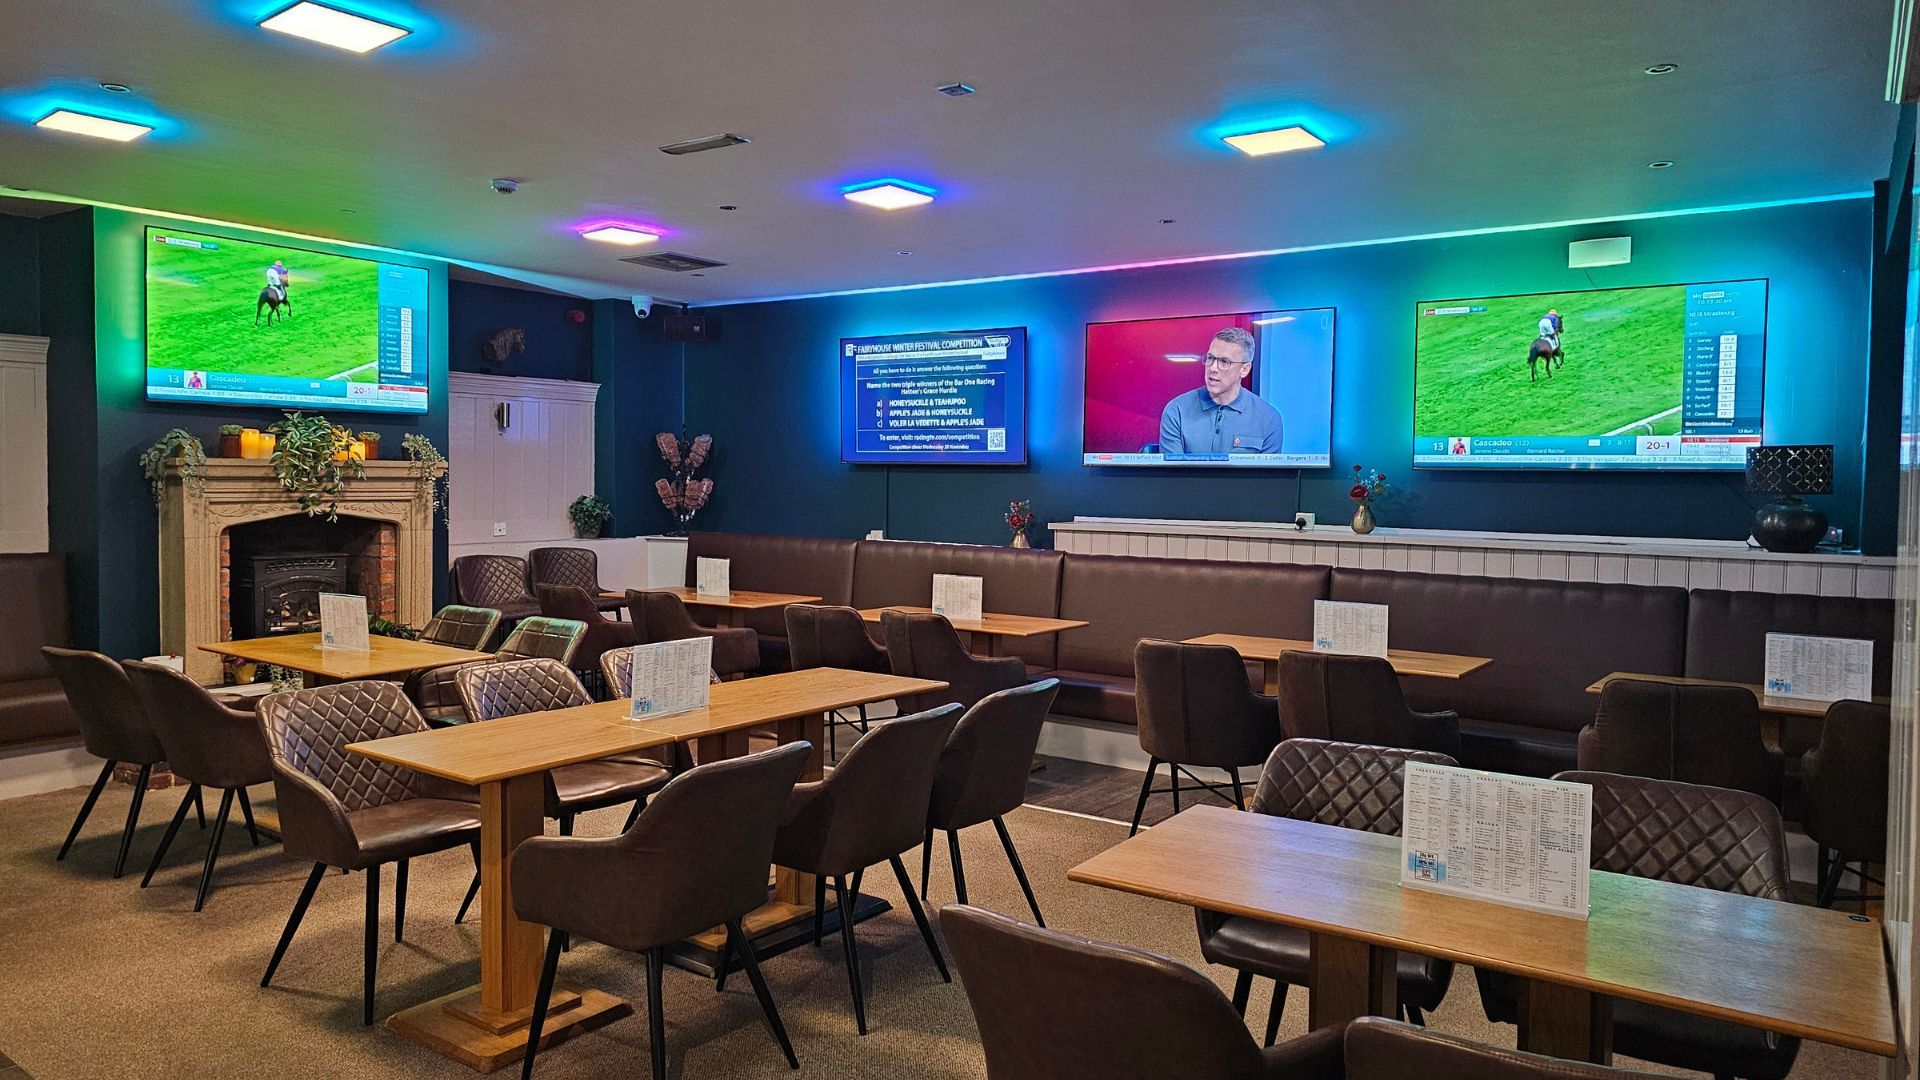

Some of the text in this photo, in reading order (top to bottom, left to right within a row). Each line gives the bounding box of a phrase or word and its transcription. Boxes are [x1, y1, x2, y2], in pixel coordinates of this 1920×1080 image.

[857, 344, 892, 353] FAIRYHOUSE
[892, 342, 915, 352] WINTER
[915, 340, 941, 351] FESTIVAL
[941, 338, 983, 349] COMPETITION
[942, 364, 964, 372] following
[168, 374, 179, 383] 13
[902, 381, 916, 389] triple
[976, 378, 995, 386] Racing
[353, 386, 371, 395] 20-1
[876, 399, 883, 408] a)
[889, 399, 929, 407] HONEYSUCKLE
[935, 398, 966, 406] TEAHUPOO
[876, 409, 883, 418] b)
[889, 409, 911, 417] APPLE'S
[931, 408, 972, 416] HONEYSUCKLE
[877, 419, 883, 428] c)
[889, 419, 907, 427] VOLER
[908, 419, 916, 427] LA
[946, 418, 969, 426] APPLE'S
[969, 418, 984, 426] JADE
[886, 434, 901, 442] enter,
[914, 434, 980, 442] racingtv.com/competition
[1433, 442, 1444, 451] 13
[1473, 439, 1512, 447] Cascadeo
[1646, 441, 1670, 450] 20-1
